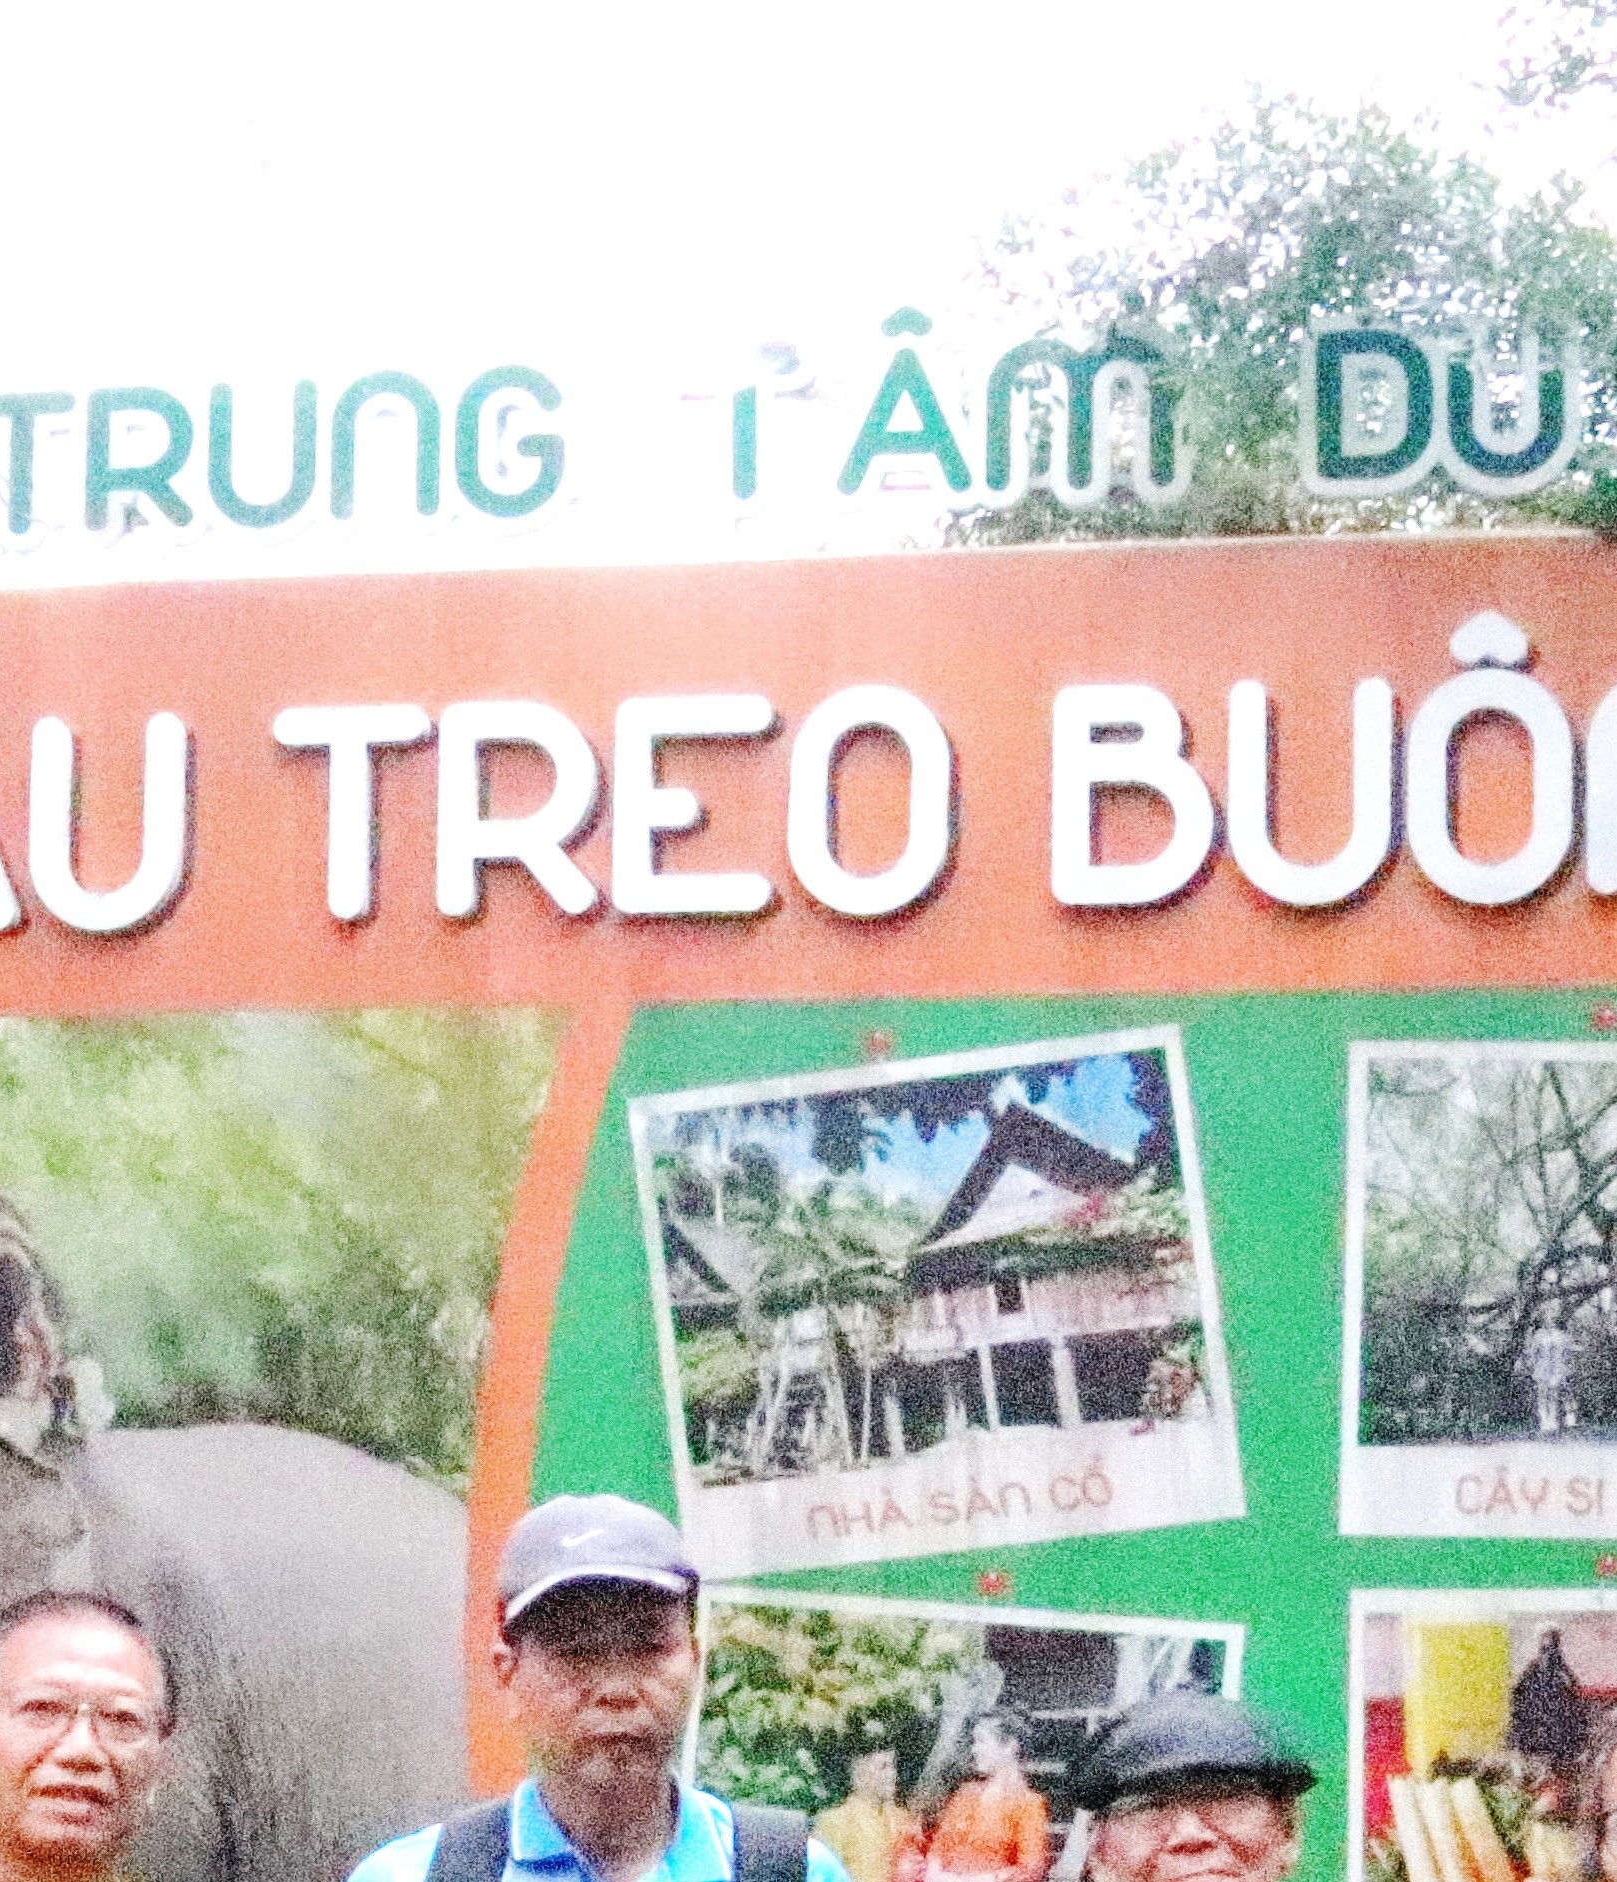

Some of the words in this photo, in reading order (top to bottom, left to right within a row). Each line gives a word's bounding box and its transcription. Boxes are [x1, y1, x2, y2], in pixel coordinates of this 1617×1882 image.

[1305, 325, 1573, 495] DU
[272, 684, 956, 920] TREO
[1455, 1464, 1550, 1516] CÂY
[1566, 1475, 1604, 1517] SI
